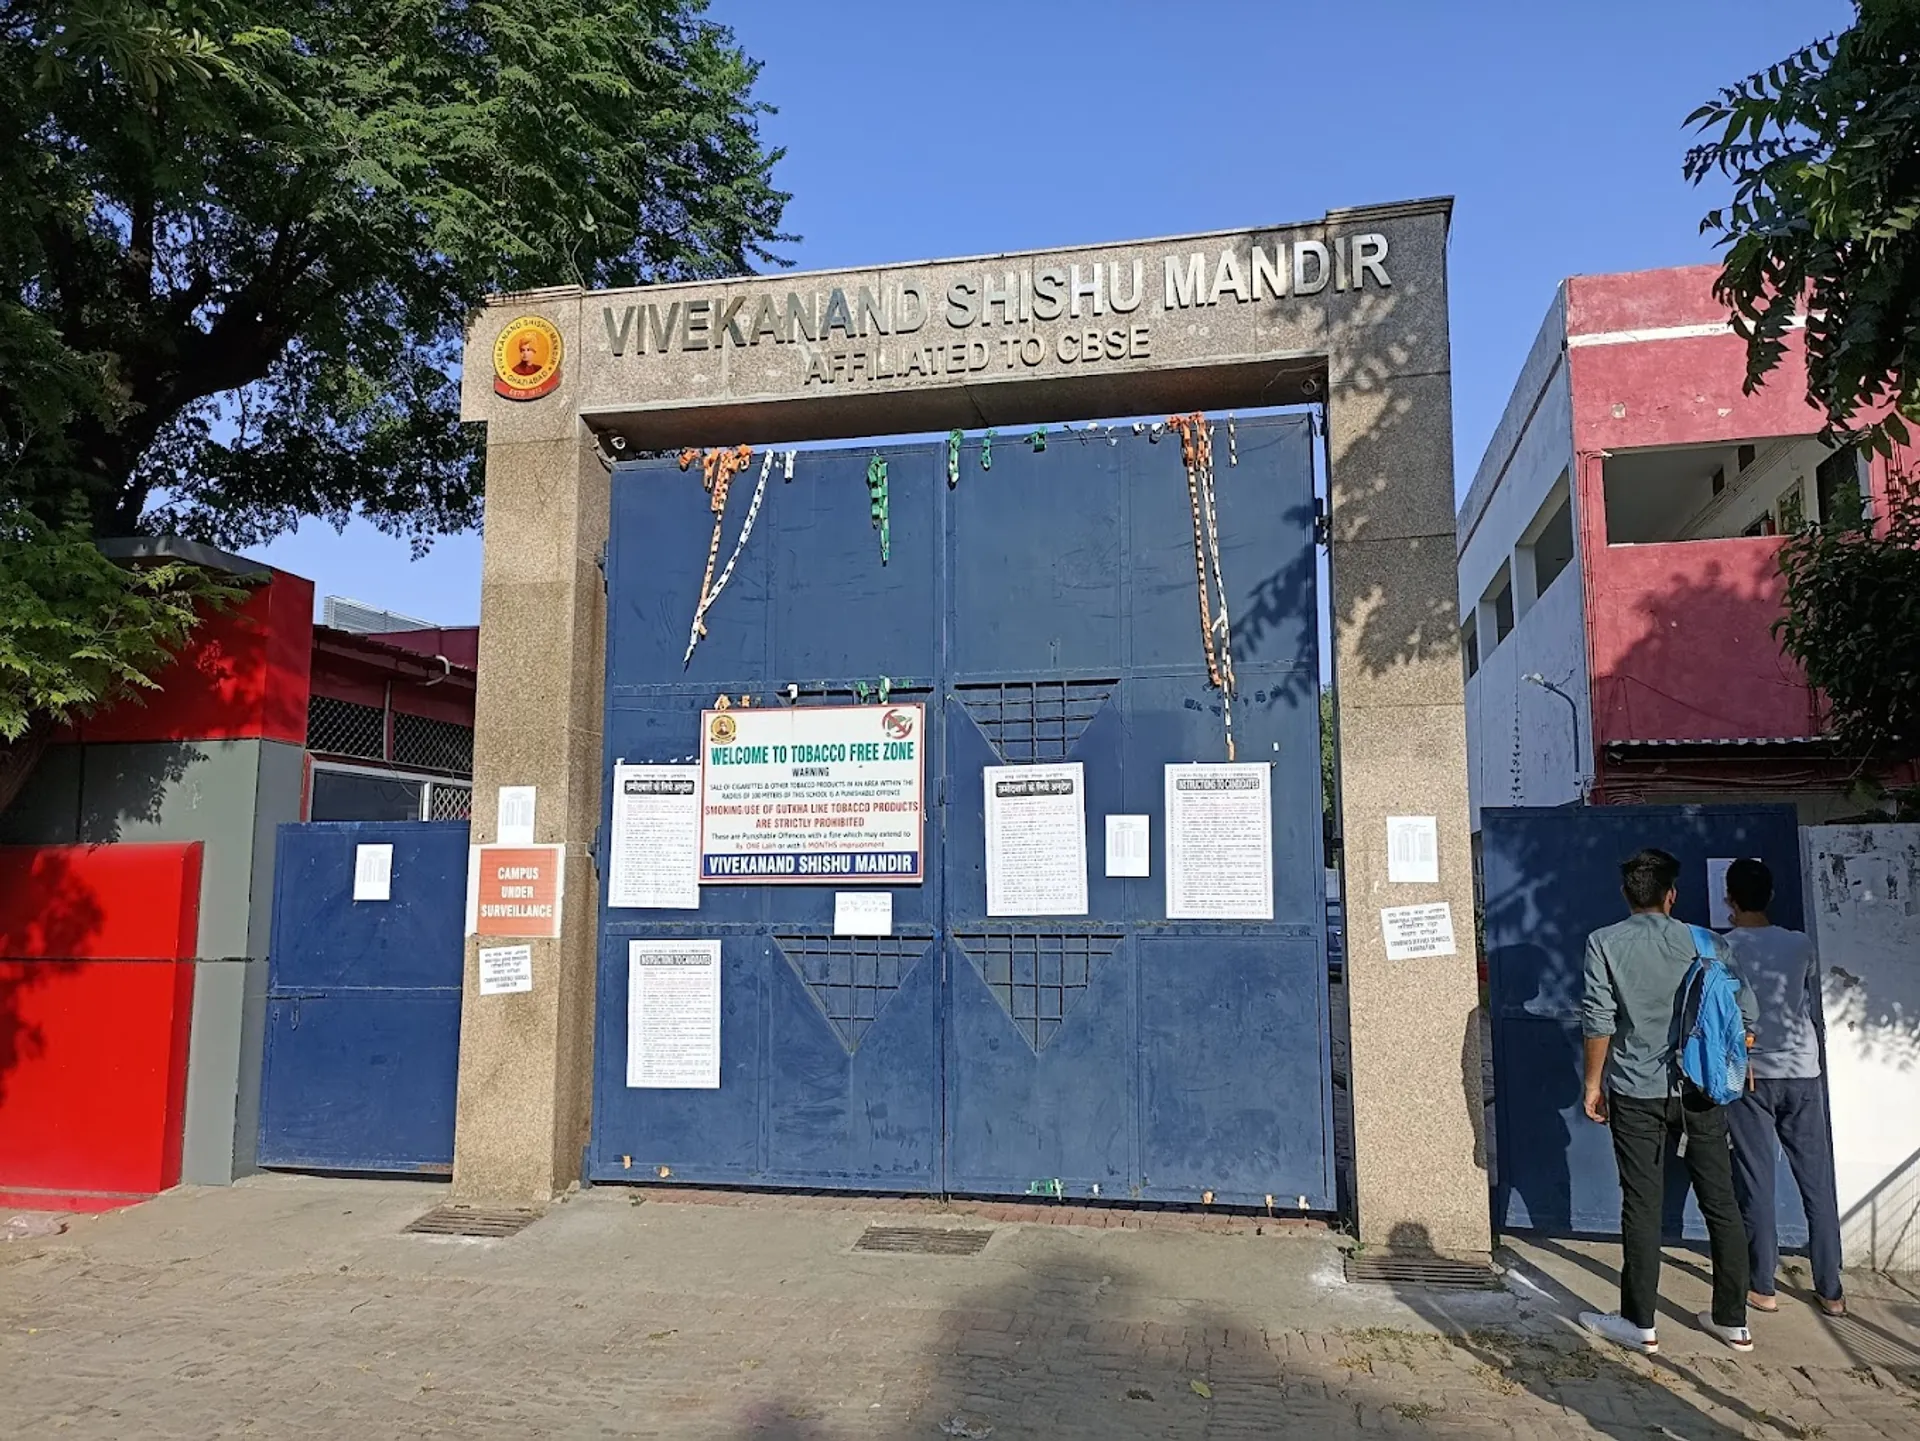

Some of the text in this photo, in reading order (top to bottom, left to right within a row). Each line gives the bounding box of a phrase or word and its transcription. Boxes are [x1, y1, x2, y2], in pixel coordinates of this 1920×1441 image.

[603, 233, 1392, 356] VIVEKANAND SHISHU MANDIR
[496, 322, 522, 370] VIVEKANAND
[804, 323, 1150, 385] AFFILIATED TO CBSE
[711, 741, 914, 765] WELCOME TO TOBACCO FREE ZONE
[792, 767, 830, 777] WARNING
[790, 781, 815, 789] TOBACCO
[816, 780, 845, 788] PRODUCTS
[865, 779, 879, 787] AREA
[744, 804, 760, 815] USE
[763, 804, 774, 814] OF
[776, 804, 808, 814] GUTKHA
[811, 803, 828, 813] LIKE
[831, 802, 870, 813] TOBACCO
[873, 801, 918, 812] PRODUCTS
[756, 817, 864, 828] ARE STRICTLY PROHIBITED
[711, 832, 729, 840] These
[742, 832, 776, 840] Punishable
[778, 831, 806, 839] Offences
[808, 831, 822, 839] with
[709, 854, 912, 874] VIVEKANAND SHISHU MANDIR
[498, 867, 539, 880] CAMPUS
[501, 885, 534, 898] UNDER
[481, 904, 552, 918] SURVEILLANCE
